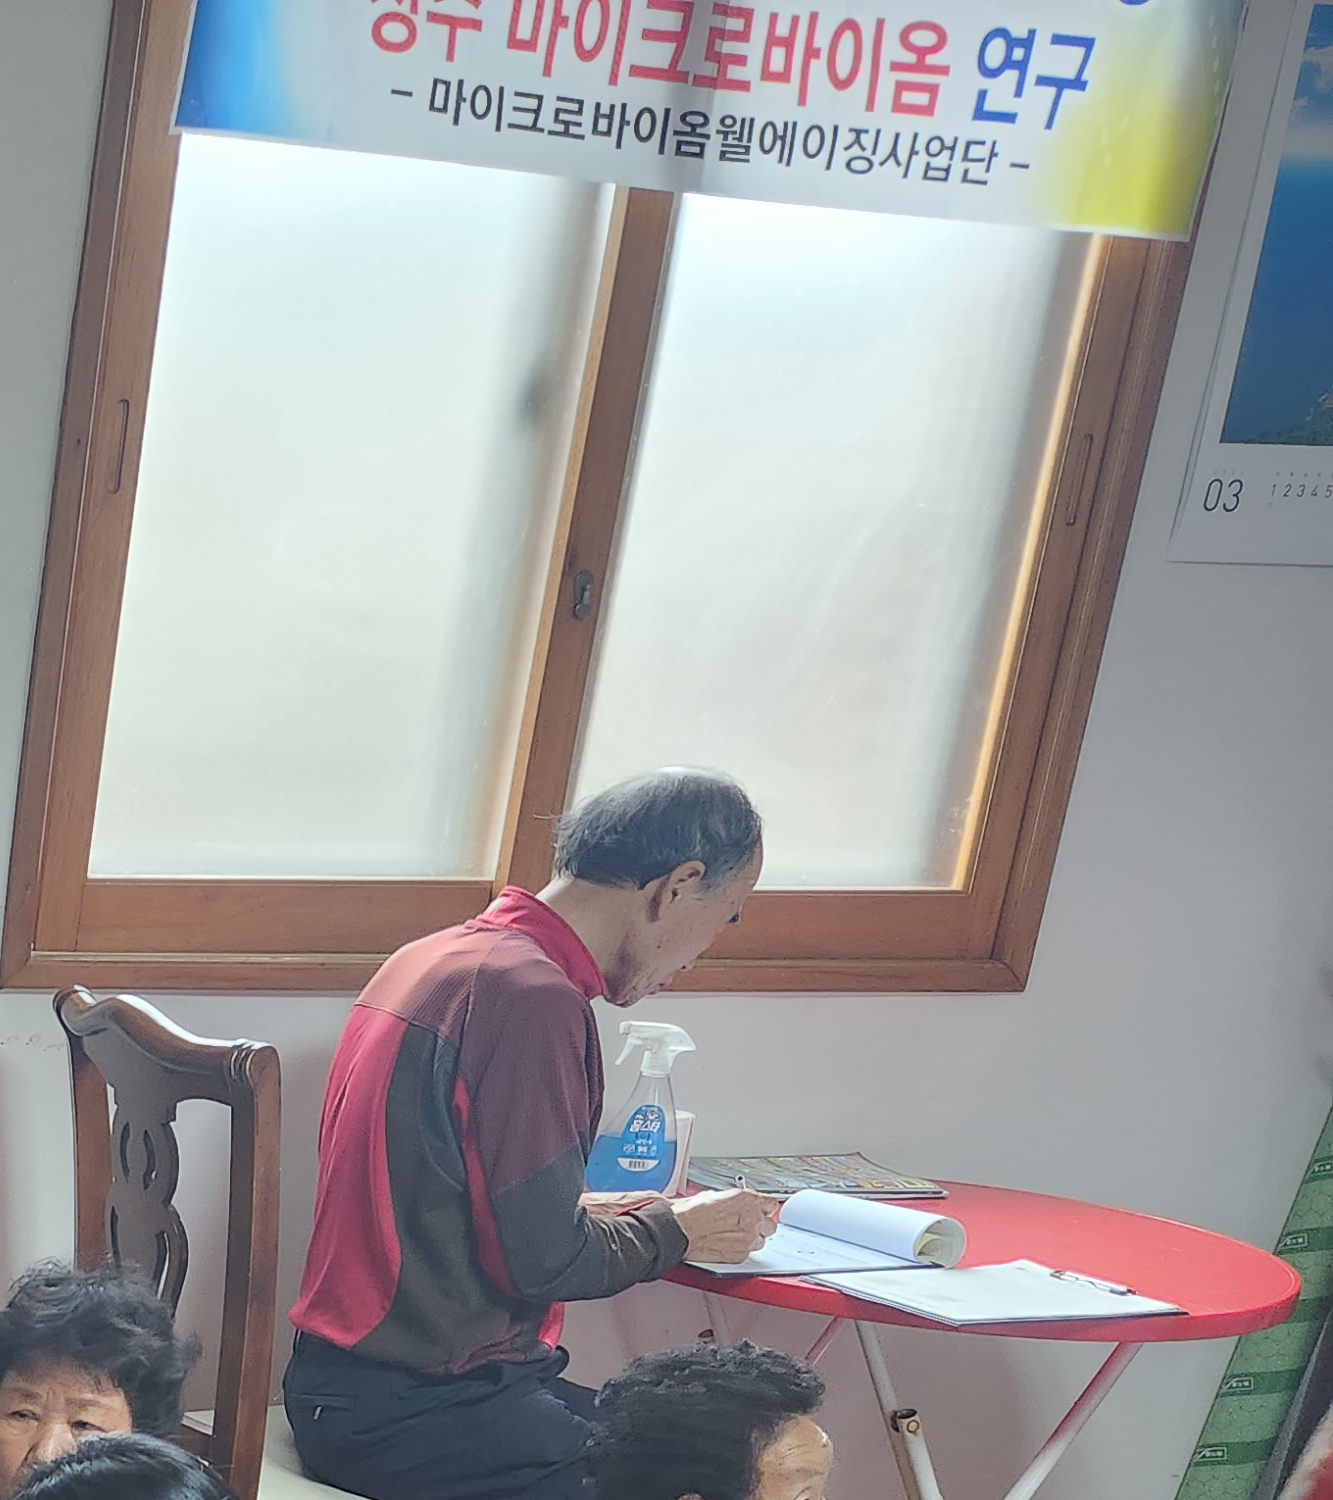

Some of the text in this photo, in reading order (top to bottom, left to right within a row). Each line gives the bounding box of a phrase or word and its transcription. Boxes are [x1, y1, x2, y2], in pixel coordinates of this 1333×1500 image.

[507, 0, 951, 117] 마이크로바이옴
[972, 26, 1096, 131] 연구
[428, 77, 1000, 186] 마이크로바이옴웰에이징사업단
[1203, 478, 1244, 512] 03
